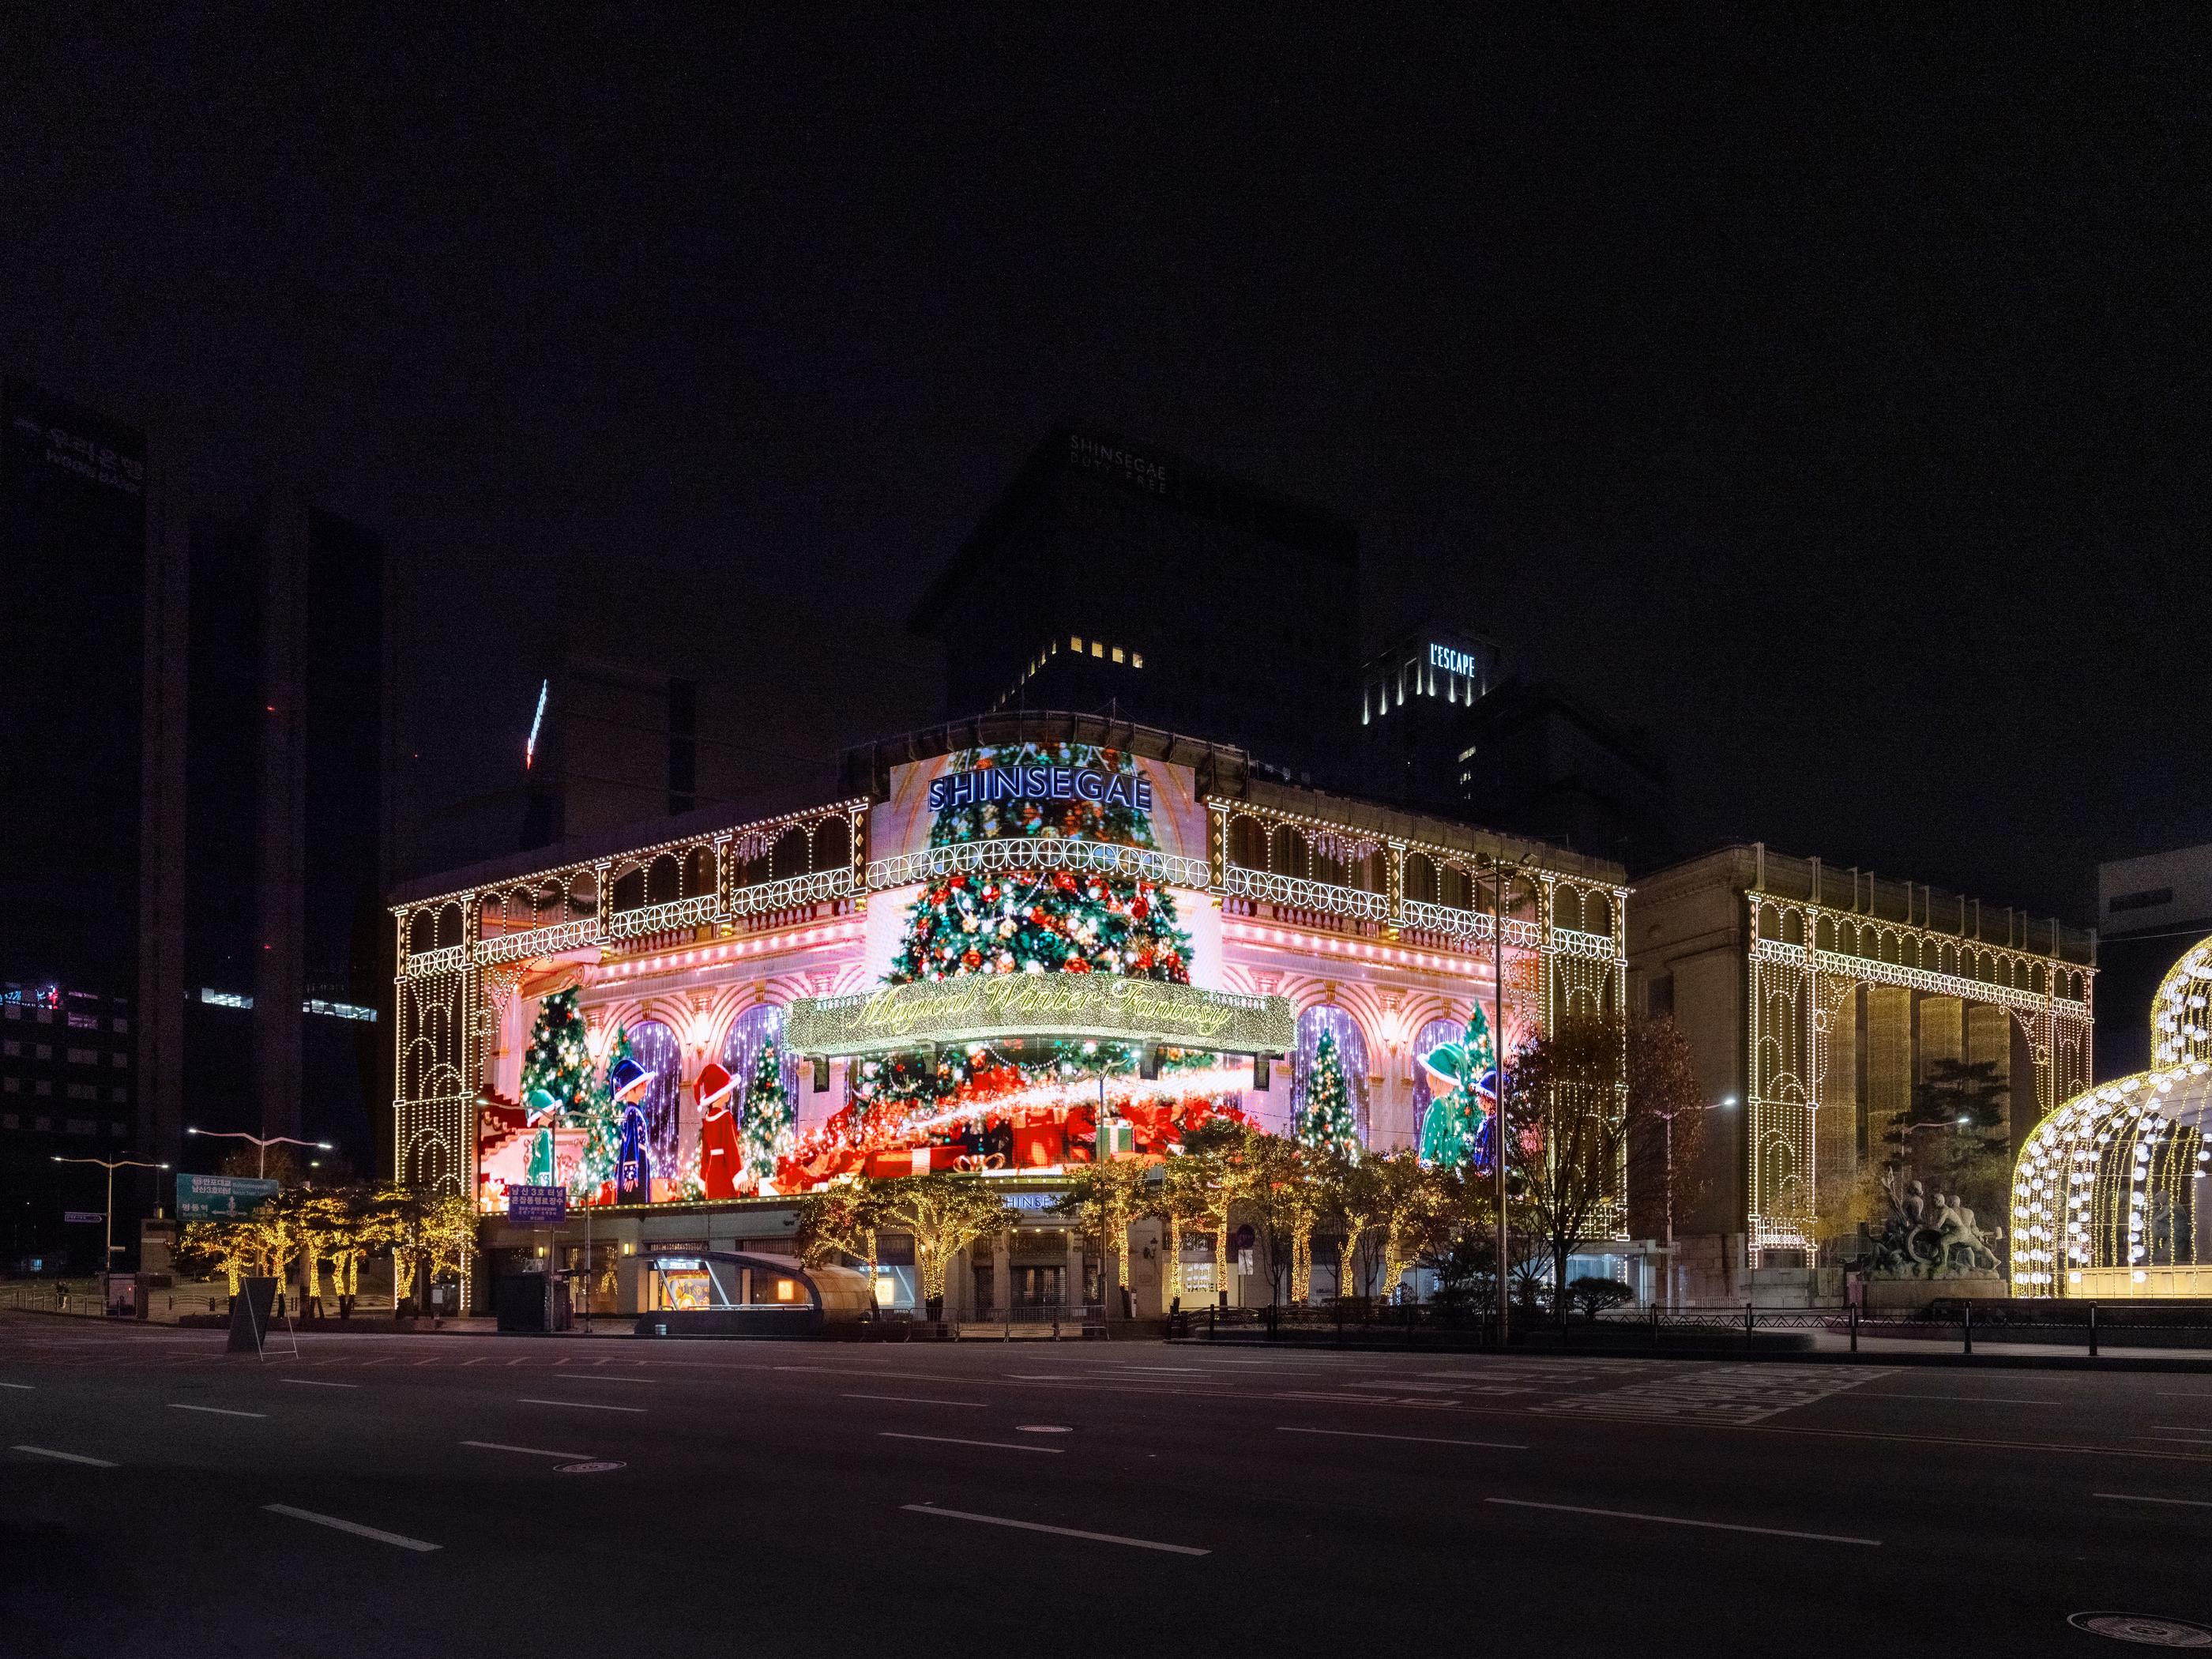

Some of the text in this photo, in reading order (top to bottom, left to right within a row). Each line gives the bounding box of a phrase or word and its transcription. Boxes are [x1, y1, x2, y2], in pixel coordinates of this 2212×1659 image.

[1070, 434, 1166, 481] SHINSEGAE
[1070, 451, 1166, 495] DUTY FREE
[1430, 642, 1476, 678] L'ESCAPE
[928, 765, 1153, 813] SHINSEGAE
[846, 972, 1231, 1037] Magical Winter Fantasy
[1005, 1196, 1059, 1208] HINSE
